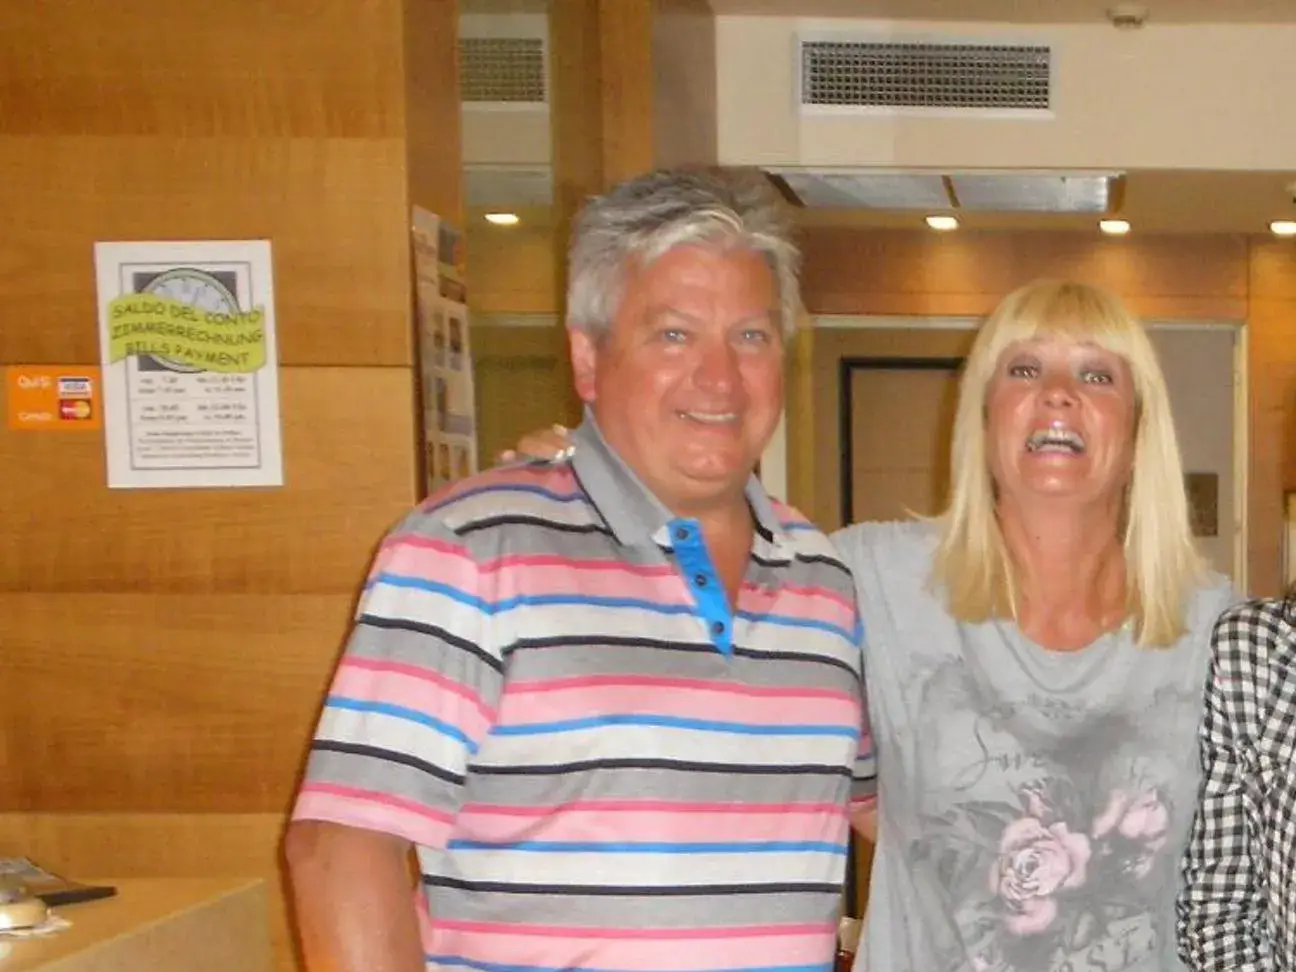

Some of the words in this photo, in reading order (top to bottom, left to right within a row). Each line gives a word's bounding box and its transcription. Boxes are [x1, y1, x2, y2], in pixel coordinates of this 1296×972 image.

[112, 301, 166, 318] SALDO
[170, 304, 199, 322] DEL
[205, 309, 260, 326] CONTO
[112, 321, 263, 346] ZIMMERRECHNUNG
[125, 340, 171, 356] BILLS
[176, 344, 250, 366] PAYMENT
